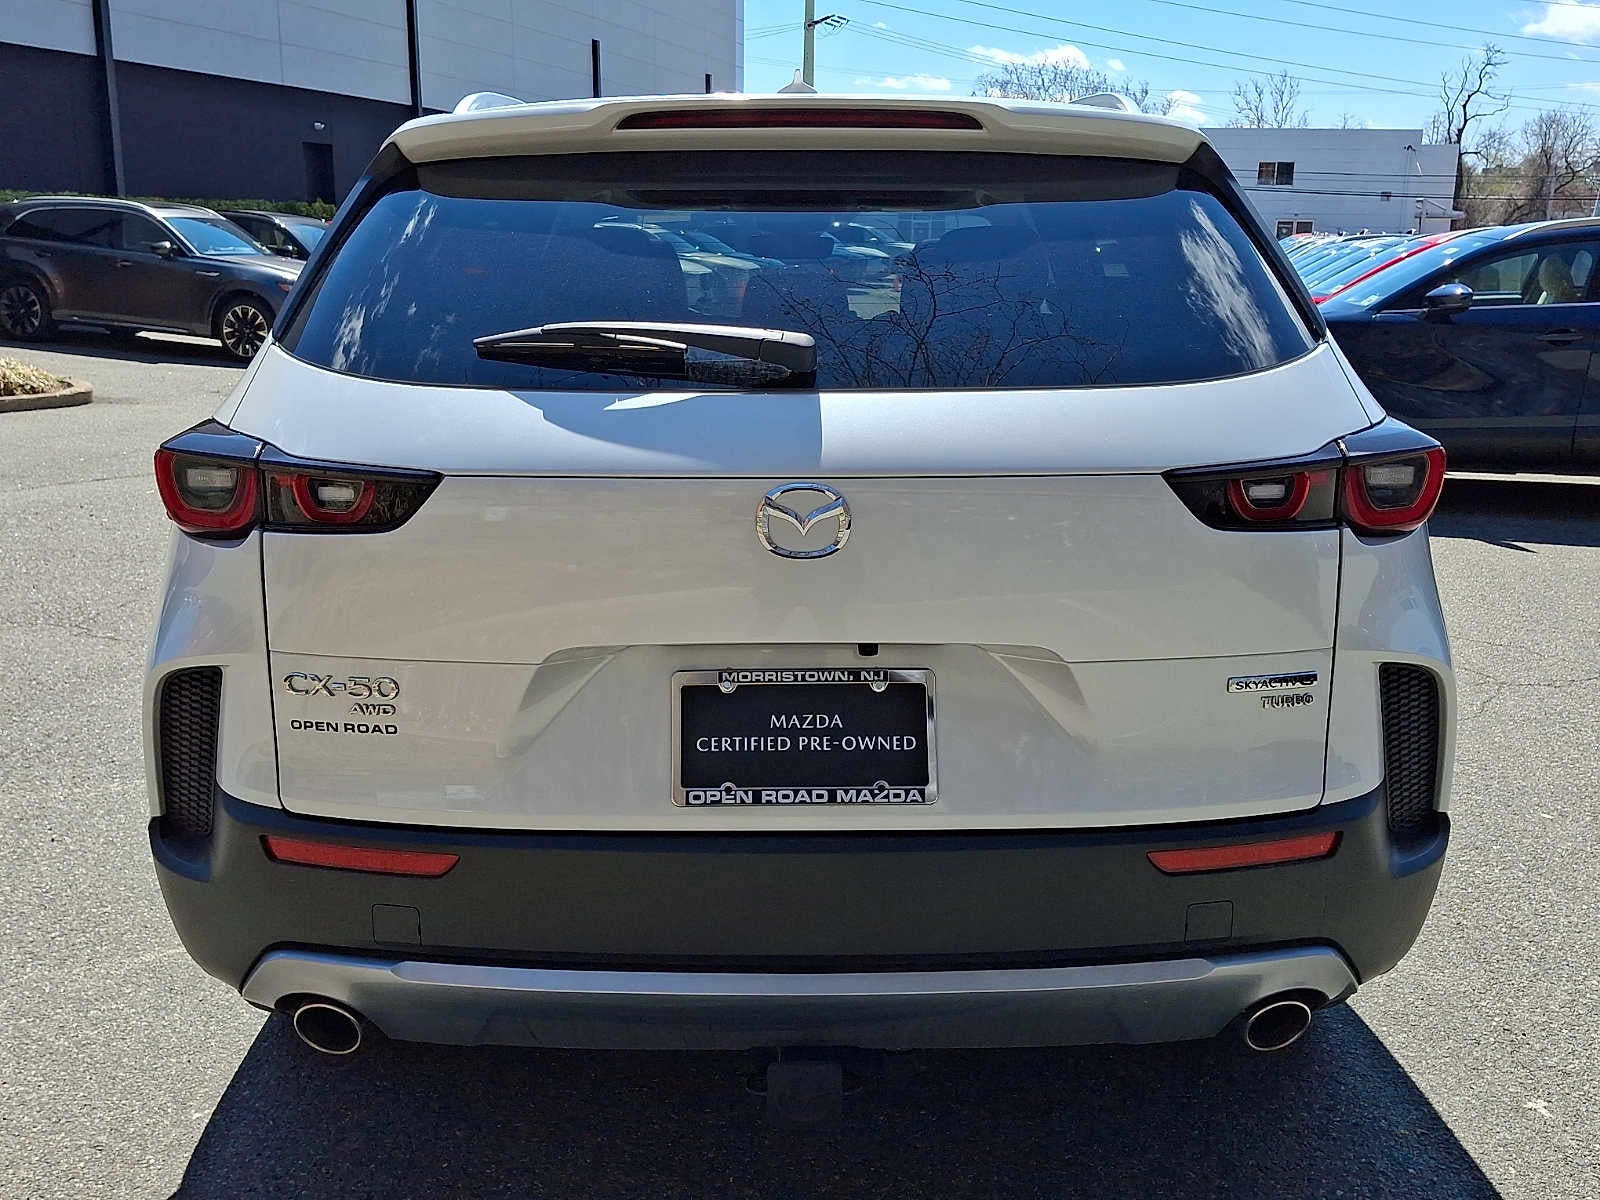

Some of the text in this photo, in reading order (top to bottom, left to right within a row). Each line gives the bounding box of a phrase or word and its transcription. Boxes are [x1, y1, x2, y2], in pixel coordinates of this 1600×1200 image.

[860, 671, 884, 681] NJ
[283, 671, 400, 701] CX-50
[1261, 693, 1314, 709] TURBO
[350, 702, 397, 716] AWD
[290, 719, 398, 735] OPEN ROAD
[770, 714, 843, 729] MAZDA
[696, 735, 917, 752] CERTIFIED PRE-OWNED
[688, 789, 923, 804] OPEN ROAD MAZDA
